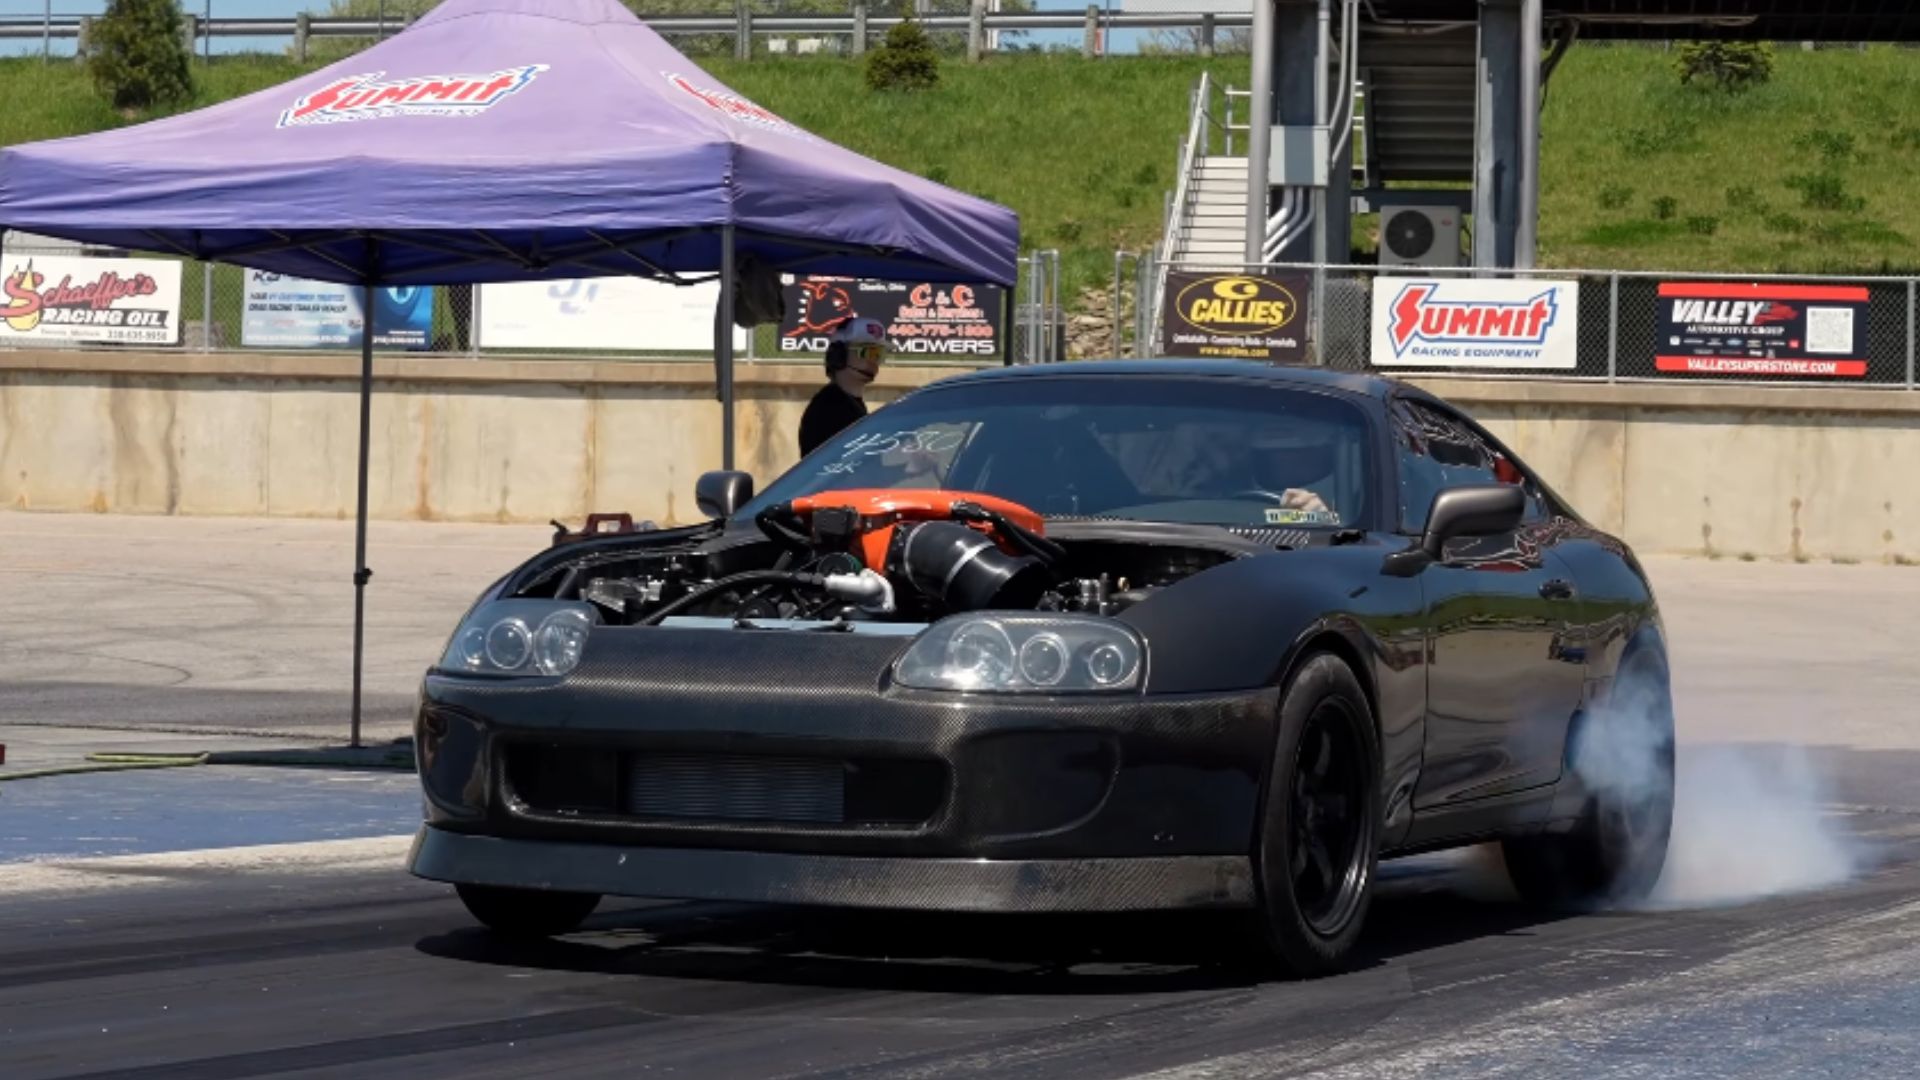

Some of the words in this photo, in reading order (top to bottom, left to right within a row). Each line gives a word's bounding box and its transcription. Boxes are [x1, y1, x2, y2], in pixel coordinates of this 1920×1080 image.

[2, 271, 158, 317] Schaeffer's
[910, 283, 932, 306] C
[935, 290, 951, 305] &
[951, 284, 976, 308] C
[42, 309, 124, 325] RACING
[127, 311, 163, 326] OIL
[1190, 298, 1286, 326] CALLIES
[1392, 287, 1549, 346] SUMMIT
[1671, 298, 1765, 325] VALLEY
[1686, 325, 1749, 335] AUTOMOTIVE
[1751, 326, 1785, 336] GROUP
[781, 337, 829, 352] BAD
[892, 338, 996, 354] MOWERS
[1199, 346, 1270, 357] www.callies.com
[1411, 347, 1461, 357] RACING
[1463, 348, 1543, 359] EQUIPMENT
[1687, 358, 1837, 374] VALLEYSUPERSTORE.COM
